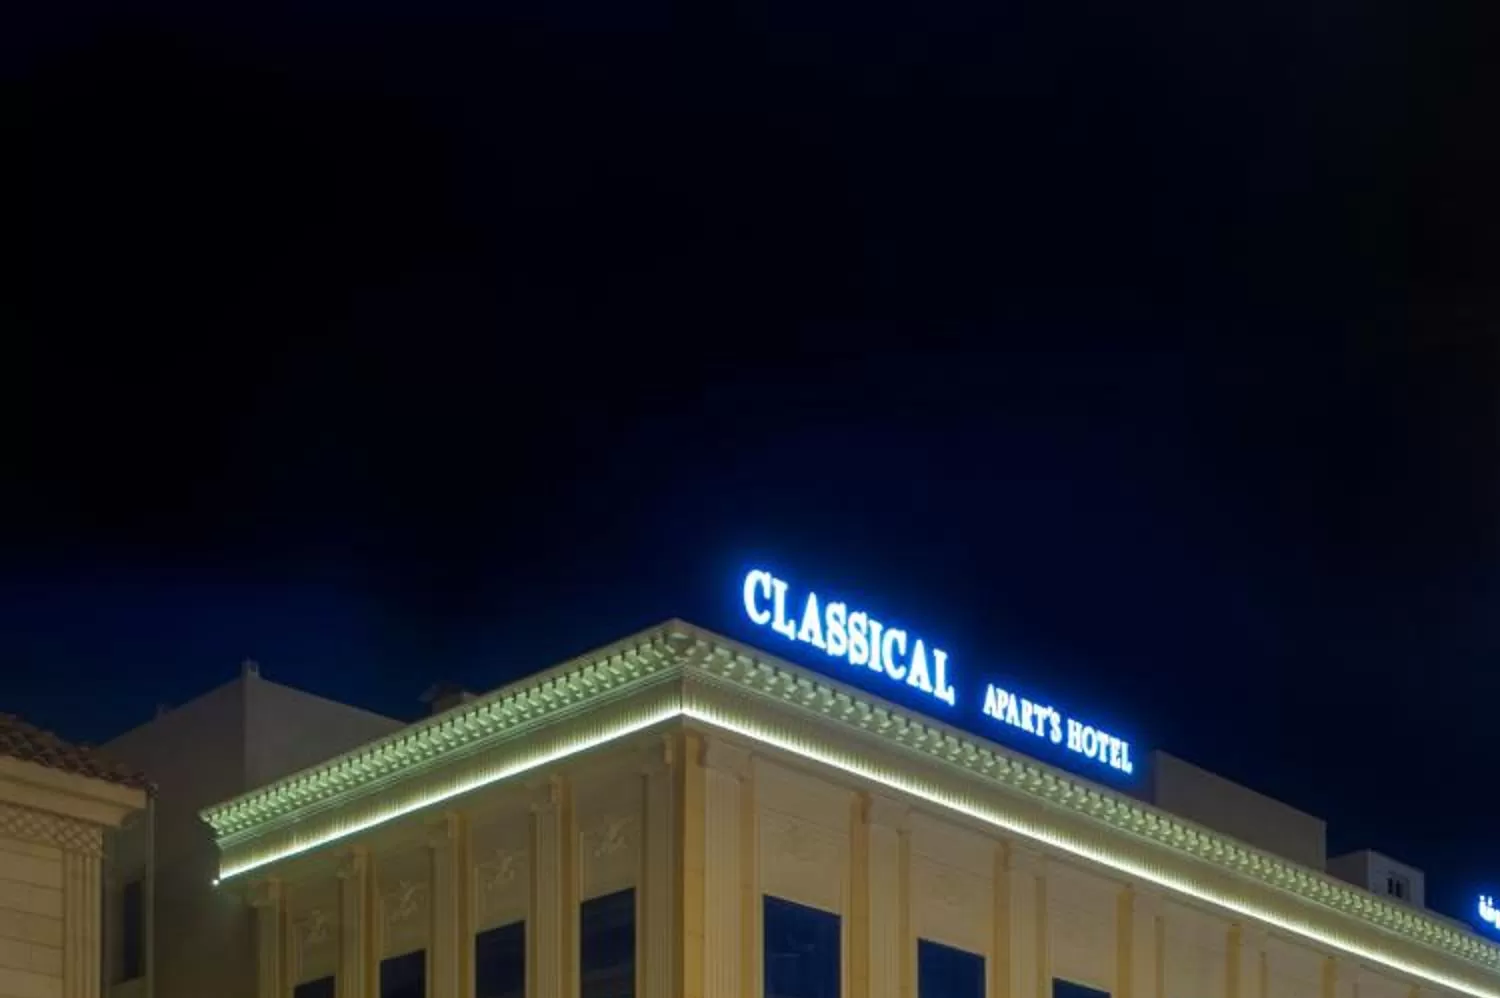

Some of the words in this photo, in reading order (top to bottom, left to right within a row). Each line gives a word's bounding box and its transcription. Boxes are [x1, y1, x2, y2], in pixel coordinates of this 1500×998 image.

[743, 568, 955, 706] CLASSICAL
[982, 683, 1062, 744] APART'S
[1066, 717, 1133, 774] HOTEL
